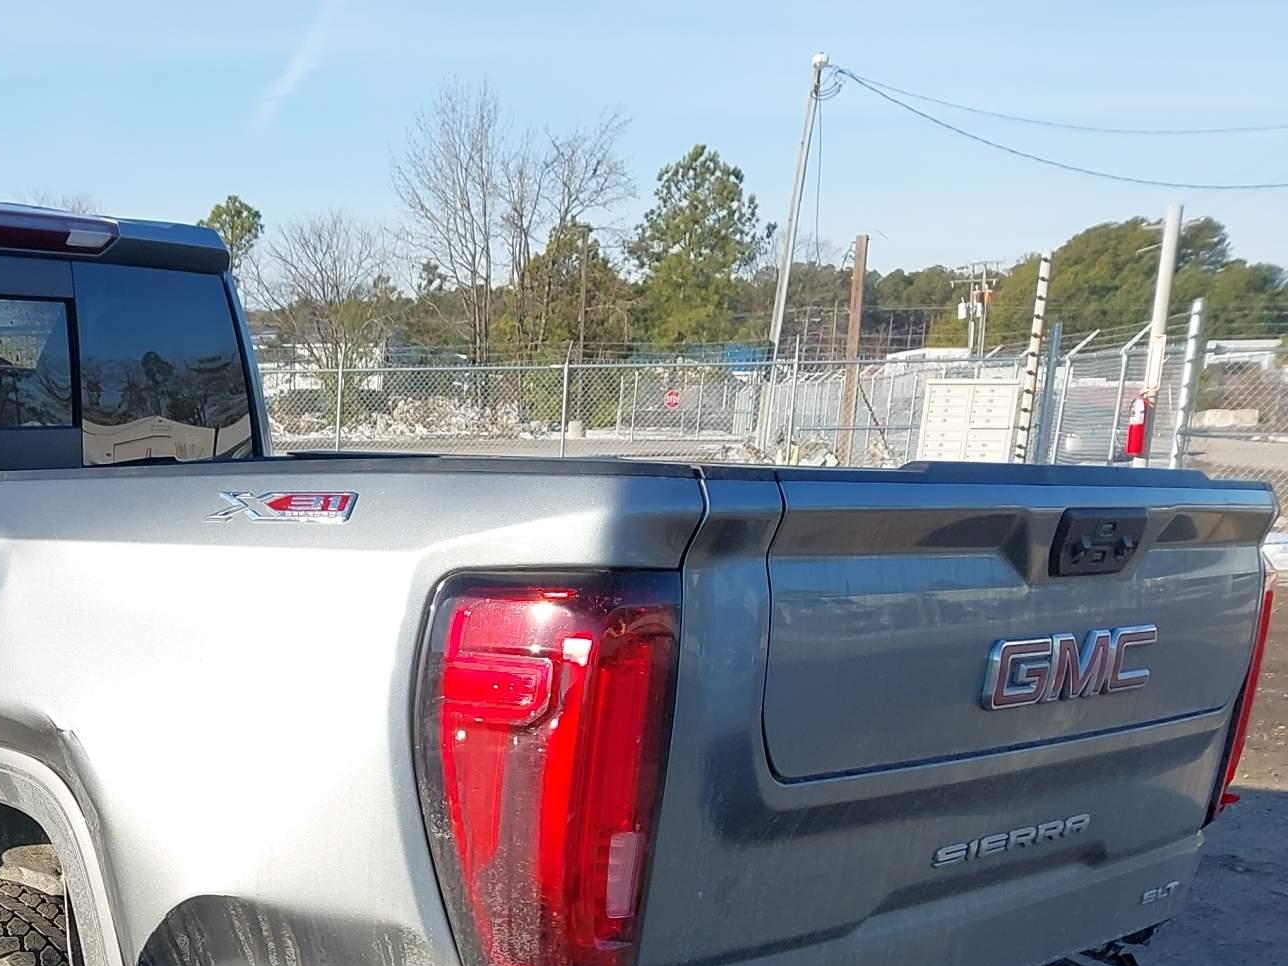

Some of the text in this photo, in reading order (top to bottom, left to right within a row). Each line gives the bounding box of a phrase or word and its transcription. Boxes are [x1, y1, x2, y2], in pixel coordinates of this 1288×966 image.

[982, 624, 1158, 711] GMC
[931, 813, 1091, 868] SIERRA
[1140, 880, 1180, 905] SLT
